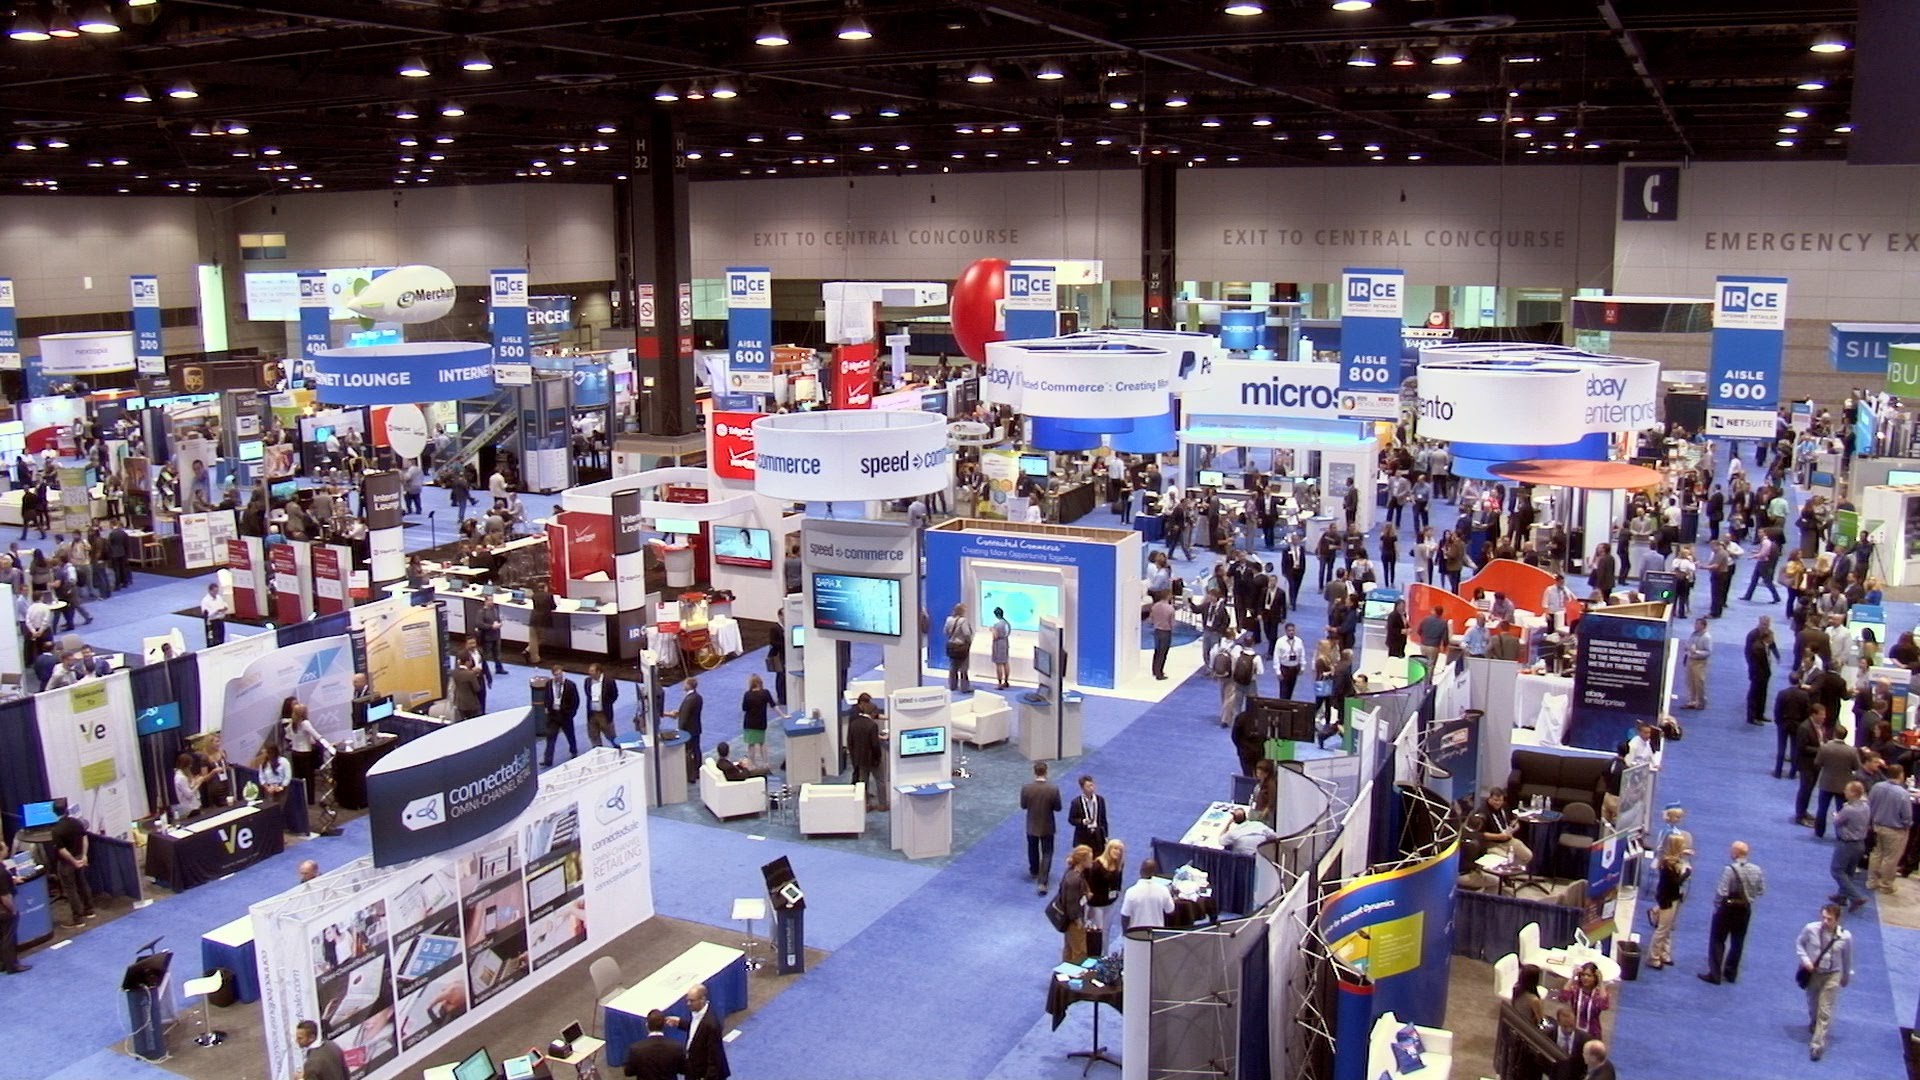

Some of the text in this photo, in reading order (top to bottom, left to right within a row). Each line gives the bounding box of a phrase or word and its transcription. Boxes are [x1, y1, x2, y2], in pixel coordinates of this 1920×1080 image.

[636, 139, 646, 151] H
[676, 139, 685, 151] H
[634, 155, 649, 169] 32
[754, 229, 1019, 247] EXIT TO CENTRAL CONCOURSE
[1223, 229, 1565, 248] EXIT TO CENTRAL CONCOURSE
[1705, 232, 1920, 253] EMERGENCY EX
[732, 278, 765, 292] IRCE
[1011, 277, 1051, 293] IRCE
[1349, 280, 1396, 298] IRCE
[1723, 289, 1778, 309] IRCE
[502, 336, 522, 344] AISLE
[737, 340, 762, 349] AISLE
[500, 346, 525, 357] 500
[735, 350, 765, 363] 600
[1353, 355, 1387, 365] AISLE
[344, 371, 411, 387] LOUNGE
[1349, 367, 1389, 382] 800
[1724, 369, 1765, 381] AISLE
[1115, 379, 1157, 393] Creating
[1586, 373, 1627, 400] ebay
[1719, 382, 1766, 400] 900
[860, 450, 909, 478] speed
[810, 543, 904, 561] speed commerce
[218, 824, 254, 855] Ve
